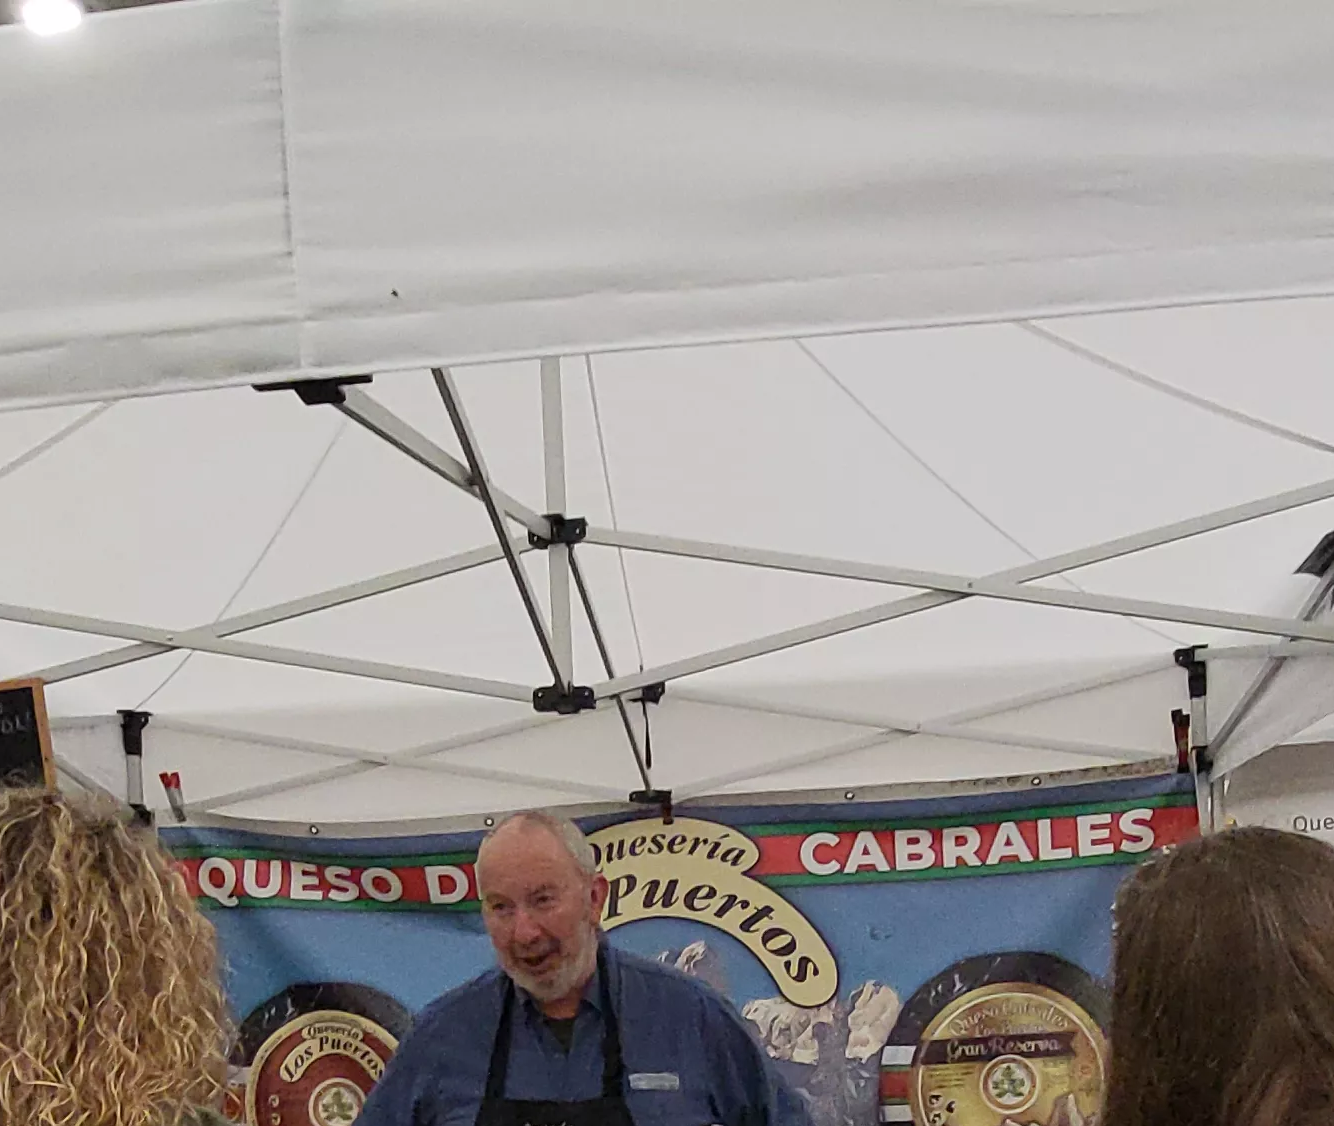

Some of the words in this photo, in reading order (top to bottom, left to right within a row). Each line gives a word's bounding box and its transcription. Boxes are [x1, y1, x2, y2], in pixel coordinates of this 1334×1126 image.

[800, 808, 1155, 876] CABRALES
[198, 857, 404, 907] QUESO
[424, 865, 484, 904] D
[603, 873, 820, 983] Puertos
[282, 1046, 314, 1080] Los
[318, 1035, 384, 1079] Puertos
[947, 1039, 989, 1064] Gran
[989, 1036, 1061, 1055] Reserva
